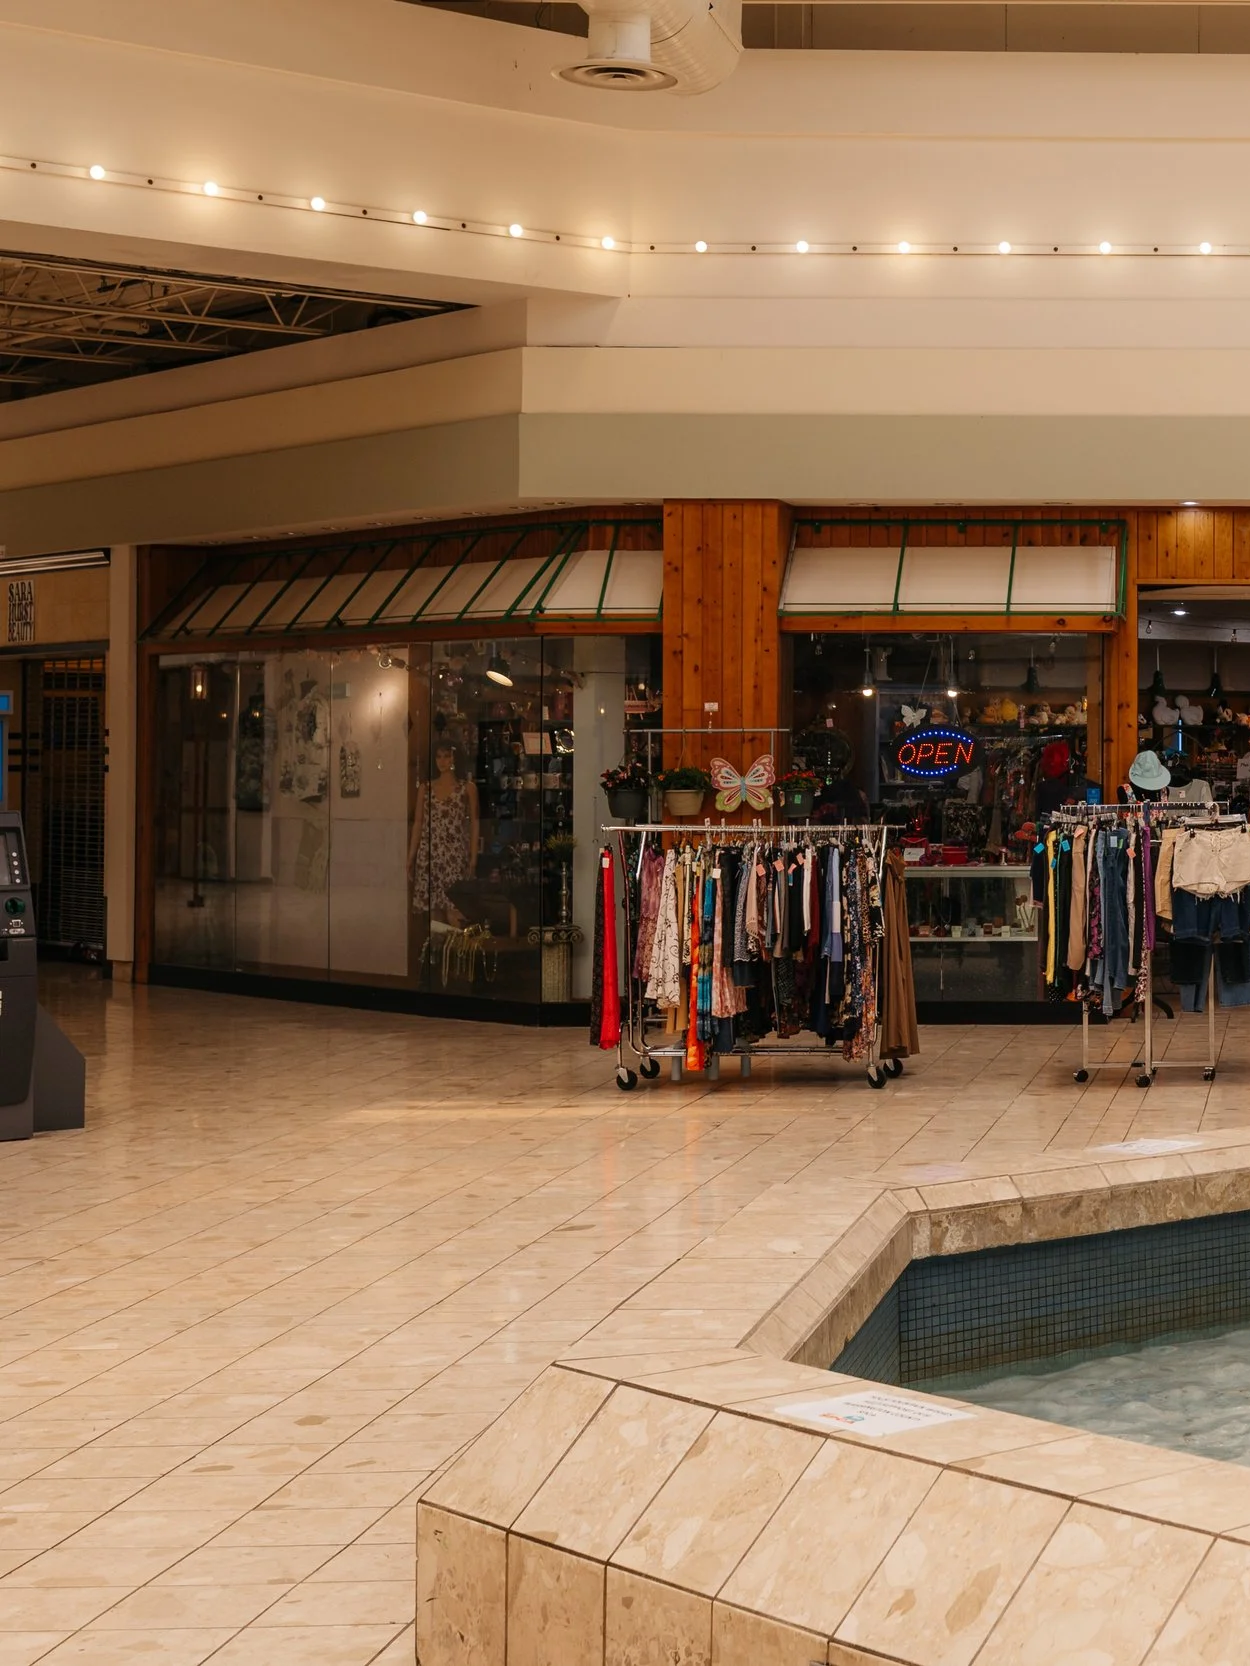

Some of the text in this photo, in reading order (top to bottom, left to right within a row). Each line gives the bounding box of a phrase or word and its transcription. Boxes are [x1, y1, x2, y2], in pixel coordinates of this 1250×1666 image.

[8, 581, 33, 602] SARA
[8, 601, 34, 621] HURST
[8, 621, 35, 642] BEAUTY
[898, 742, 974, 765] OPEN
